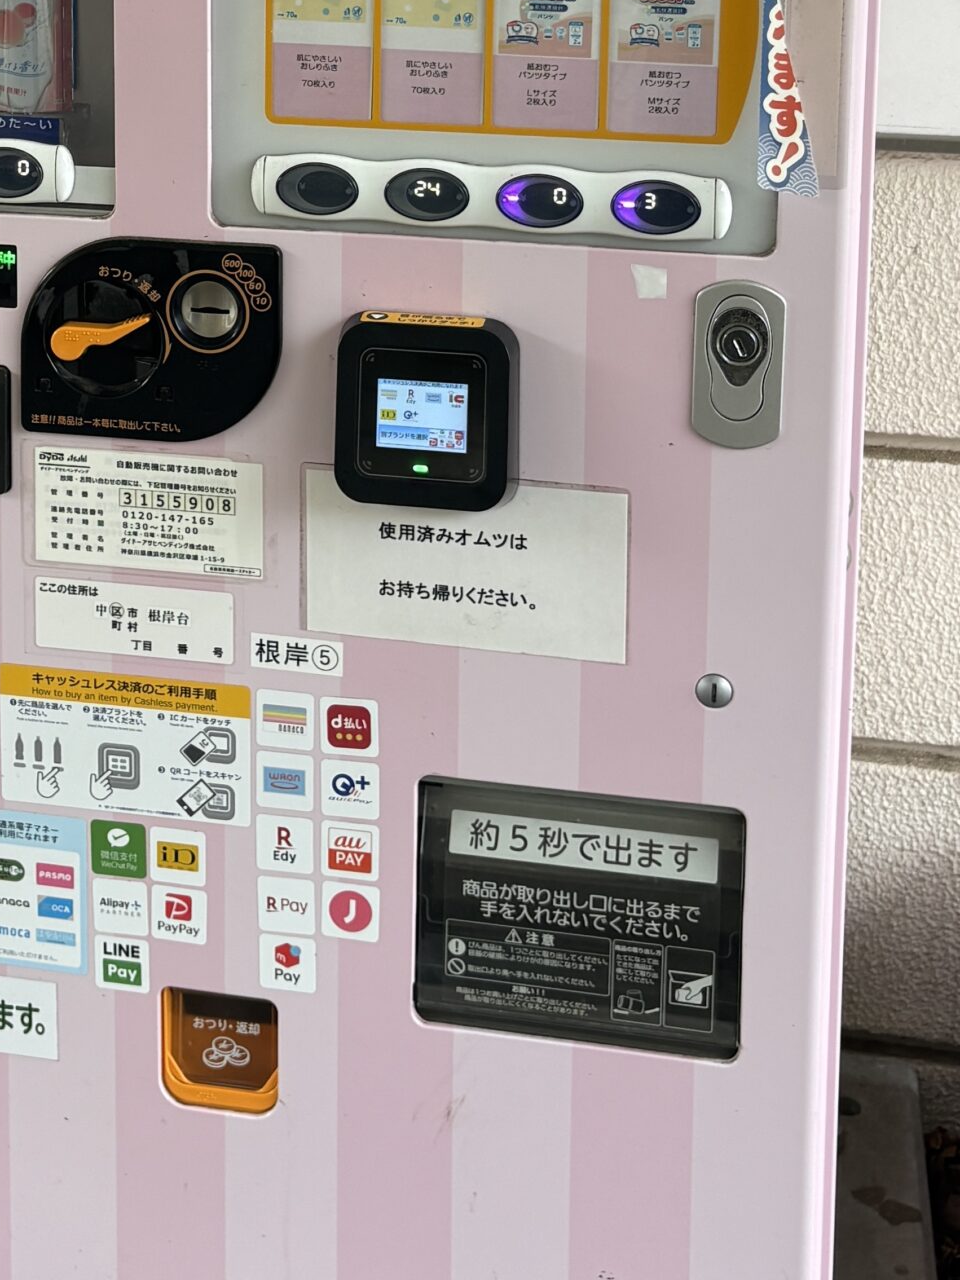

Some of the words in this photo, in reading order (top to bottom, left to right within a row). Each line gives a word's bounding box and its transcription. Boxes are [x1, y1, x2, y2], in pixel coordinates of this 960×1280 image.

[297, 54, 342, 63] 肌にやさしい
[527, 63, 559, 72] 紙おむつ
[301, 80, 335, 88] 70枚入り
[519, 72, 567, 81] パンツタイプ
[640, 79, 690, 89] パンツタイプ
[526, 98, 556, 107] 2枚入り
[648, 106, 679, 115] 2枚入り
[224, 260, 240, 268] 500
[117, 460, 238, 478] 自動販売機に関するお問い合わせ
[123, 492, 232, 512] 3155908
[122, 510, 214, 525] 0120-147-165
[379, 522, 528, 551] 使用済みオムツは
[39, 583, 98, 596] ここの住所は
[379, 579, 537, 611] お持ち帰りください。
[148, 609, 189, 626] 根岸台
[255, 638, 339, 671] 根岸⑤
[32, 672, 217, 701] キャッシュレス決済のご利用手順
[32, 687, 48, 695] How
[66, 690, 81, 700] buy
[99, 693, 118, 702] item
[121, 695, 131, 704] by
[135, 696, 173, 708] Cashless
[176, 701, 217, 712] payment.
[331, 714, 367, 729] d払い
[183, 769, 242, 781] コードをスキャン
[469, 818, 698, 872] 約5秒で出ます
[100, 850, 137, 862] 微信支付
[273, 851, 296, 864] Edy
[336, 852, 364, 866] PAY
[39, 870, 71, 881] PASMO
[100, 897, 129, 909] Alipay
[462, 880, 700, 922] 商品が取り出し口に出るまで
[480, 901, 688, 941] 手を入れないでください。
[158, 921, 200, 937] PayPay
[103, 942, 140, 958] LINE
[107, 964, 137, 981] Pay
[274, 968, 300, 984] Pay
[193, 1017, 260, 1035] おつり・返却
